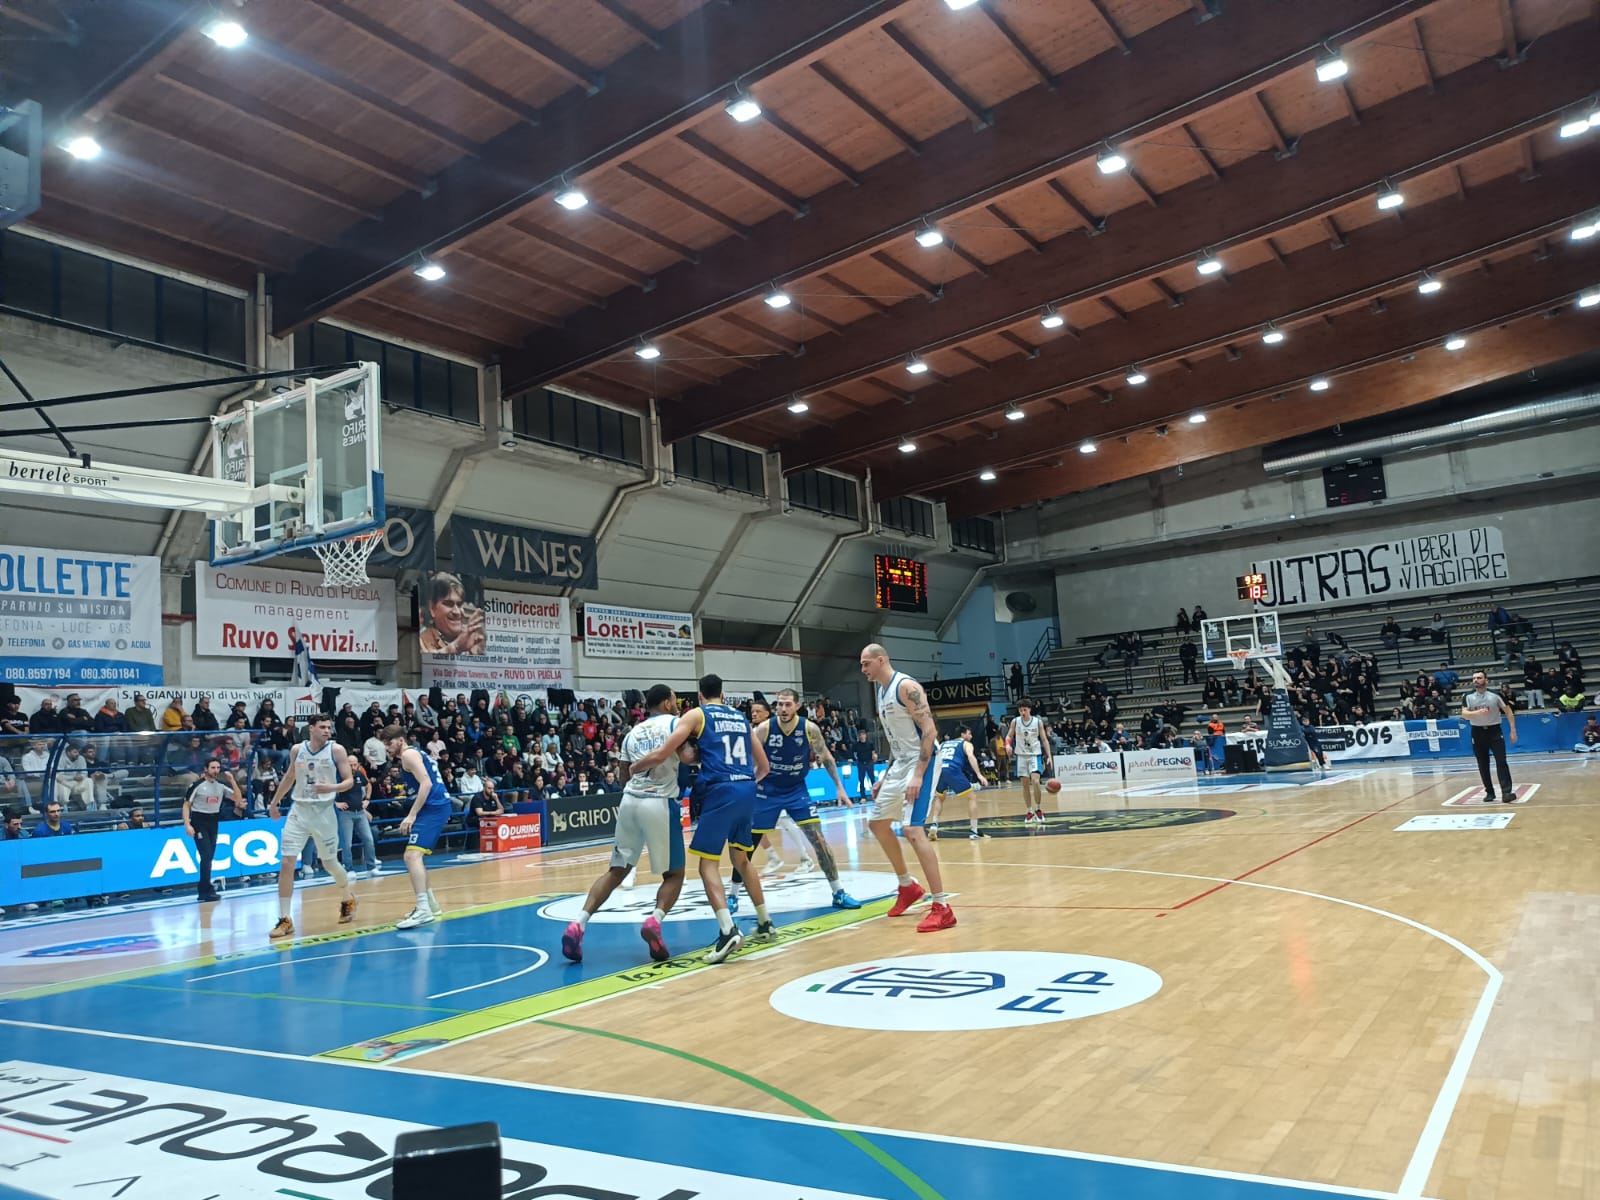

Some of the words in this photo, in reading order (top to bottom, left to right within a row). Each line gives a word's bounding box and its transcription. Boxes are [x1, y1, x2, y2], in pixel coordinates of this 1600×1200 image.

[9, 461, 71, 483] bertelè
[73, 476, 108, 486] SPORT
[1470, 528, 1490, 555] DI
[472, 528, 585, 580] WINES
[216, 573, 272, 594] COMUNE
[275, 582, 287, 594] DI
[291, 580, 324, 597] RUVO
[341, 587, 381, 601] PUGLIA
[58, 602, 73, 613] SU
[80, 603, 126, 616] MISURA
[254, 604, 350, 620] management
[62, 622, 92, 634] LUCE
[110, 623, 132, 634] GAS
[222, 623, 278, 650] Ruvo
[586, 615, 644, 639] LORETI
[7, 637, 46, 648] TELEFONIA
[68, 639, 81, 648] GAS
[131, 640, 151, 649] ACQUA
[5, 667, 71, 679] 080.8597194
[80, 668, 140, 679] 080.3601841
[504, 669, 525, 679] RUVO
[538, 670, 562, 680] PUGLIA
[146, 690, 186, 699] GIANNI
[945, 682, 991, 698] WINES
[768, 734, 784, 747] 23
[1345, 726, 1392, 748] BOYS
[722, 735, 748, 766] 14
[568, 807, 611, 828] CRIFO
[996, 971, 1115, 1014] FIP
